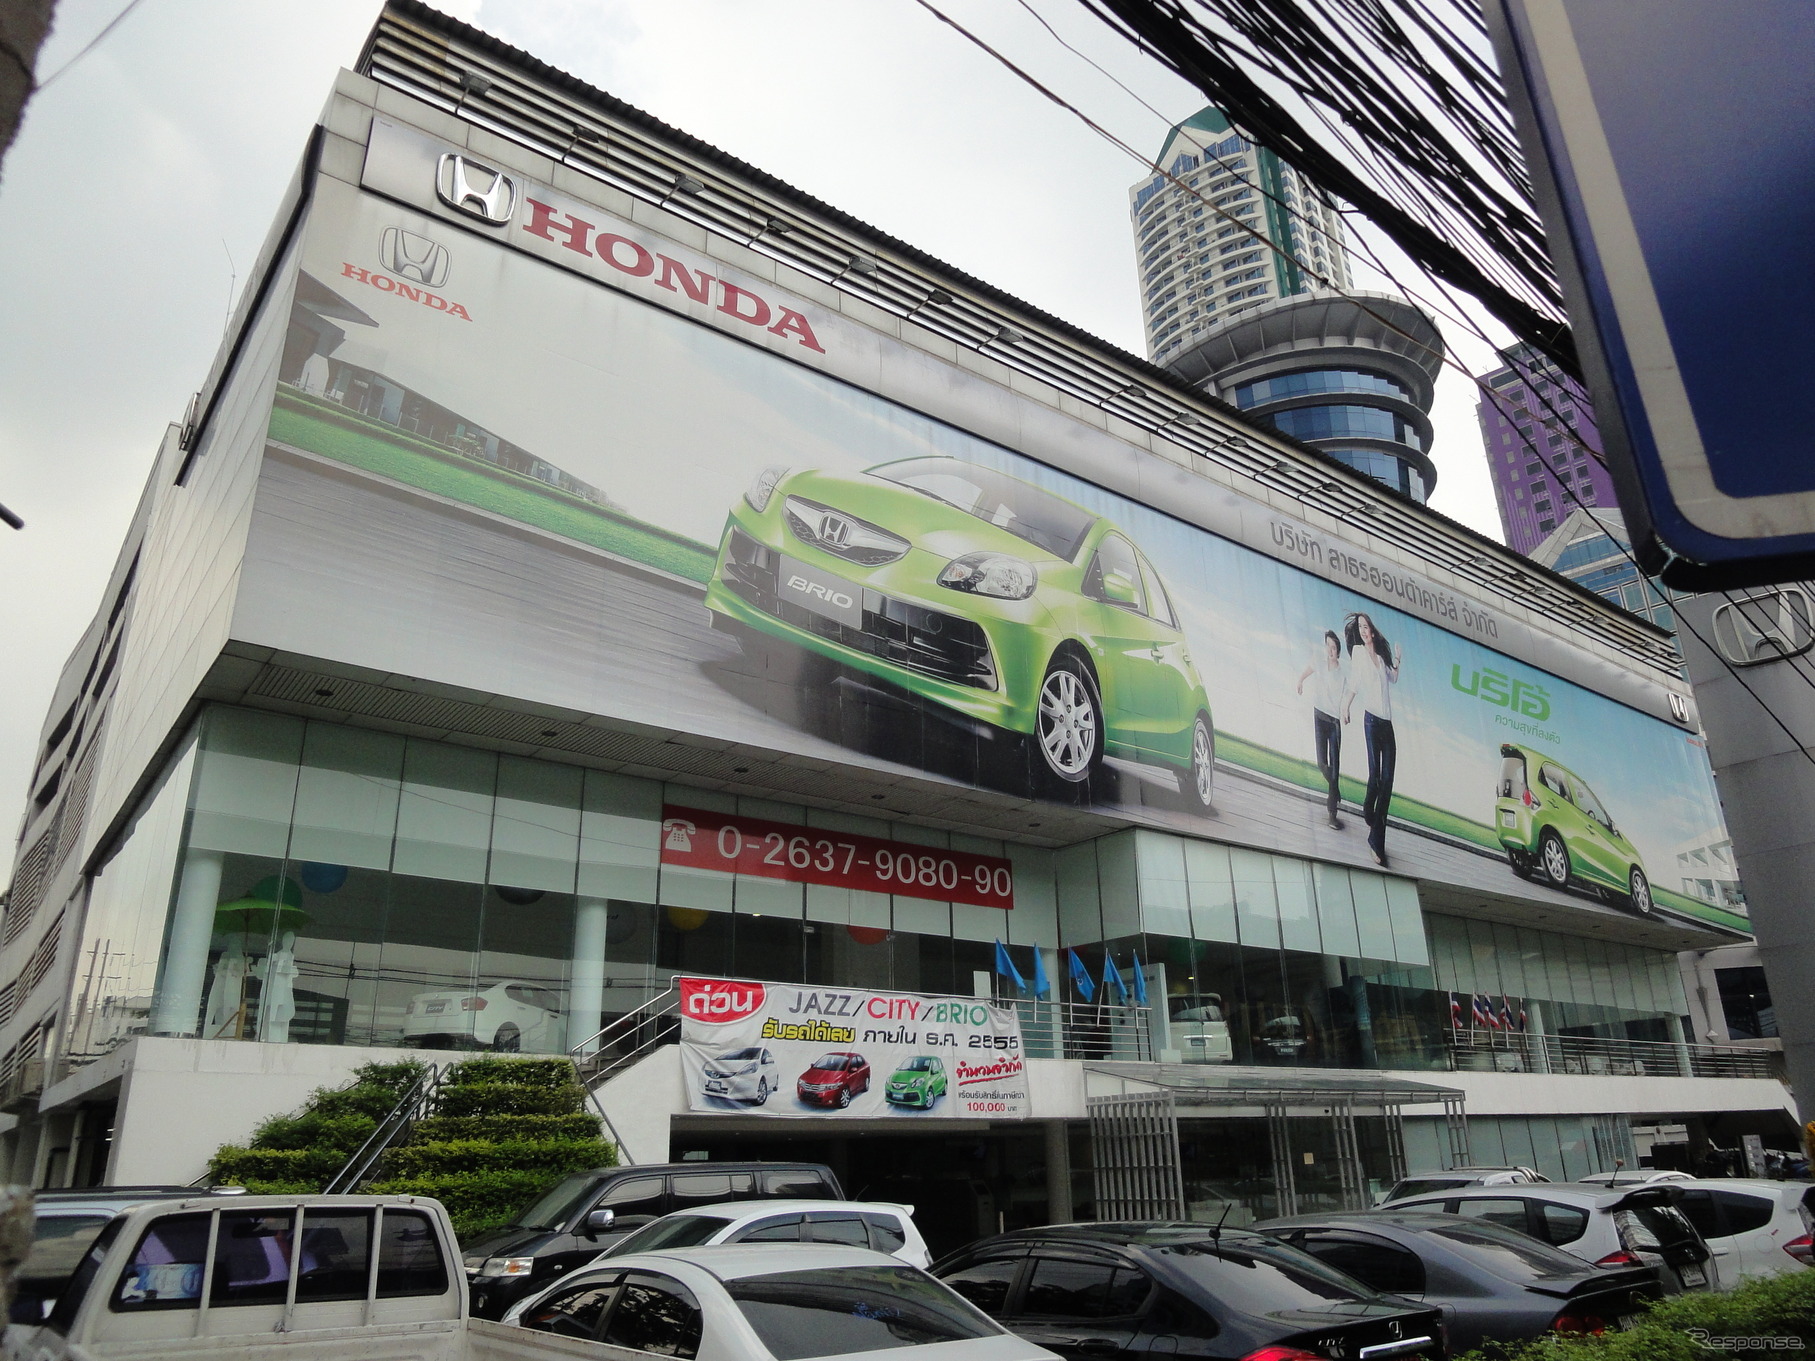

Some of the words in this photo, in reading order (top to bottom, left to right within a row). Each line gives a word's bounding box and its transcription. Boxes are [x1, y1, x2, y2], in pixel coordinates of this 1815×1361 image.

[340, 261, 473, 322] HONDA
[521, 197, 826, 355] HONDA
[787, 575, 853, 608] BRIO
[1270, 521, 1323, 564] บริษัท
[1462, 601, 1499, 639] จำกัด
[1451, 663, 1552, 722] บริโอ้
[1495, 714, 1560, 744] ความสุขที่ลงตัว
[717, 825, 1012, 897] 0-2637-9080-90
[688, 984, 753, 1014] ด่วน
[761, 1017, 857, 1043] รับรถได้เลย
[863, 1025, 917, 1045] ภายใน
[968, 1035, 1019, 1050] 2555
[967, 1102, 1006, 1112] 100,000
